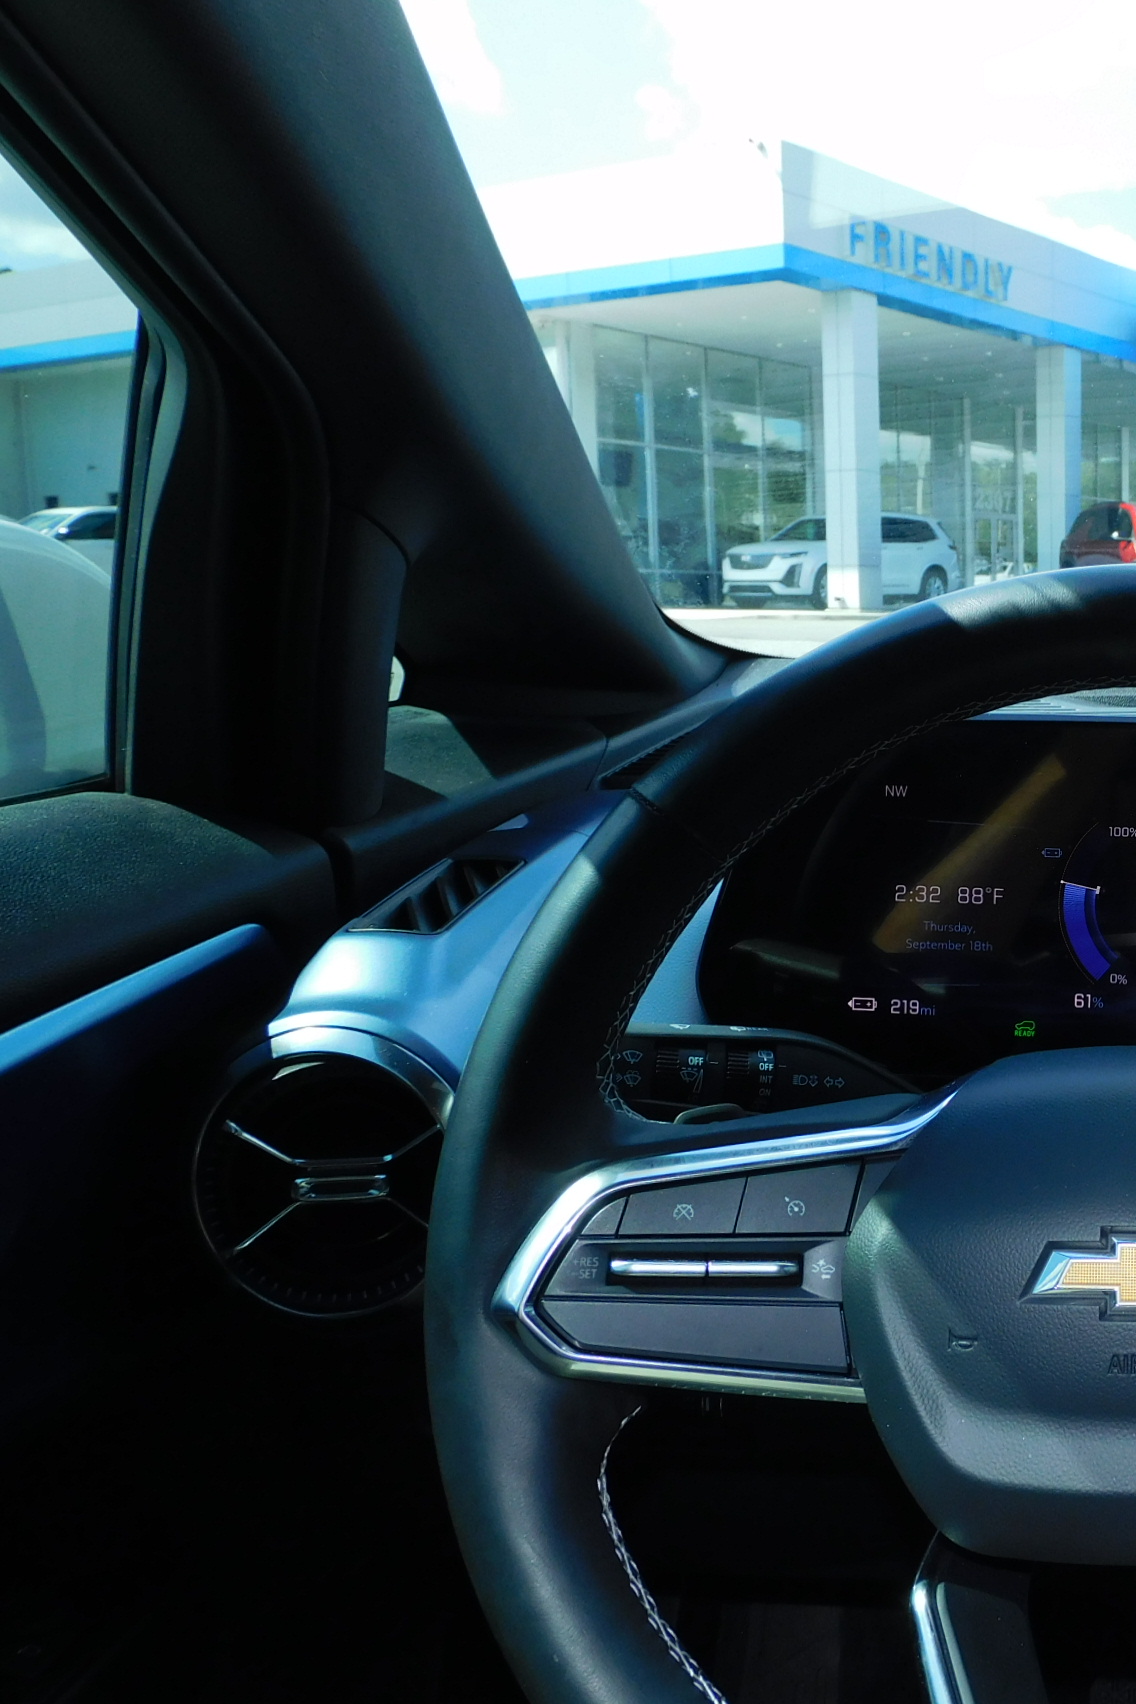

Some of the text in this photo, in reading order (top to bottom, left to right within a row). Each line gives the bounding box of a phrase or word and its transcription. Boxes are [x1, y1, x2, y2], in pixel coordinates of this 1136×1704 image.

[849, 217, 1014, 301] FRIENDLY
[885, 785, 908, 798] NW
[895, 885, 1004, 904] 2:32 88°F
[923, 921, 976, 935] Thursday,
[905, 939, 993, 954] September 18th
[1109, 973, 1128, 985] 0%
[1074, 993, 1104, 1009] 61%
[688, 1056, 704, 1066] OFF
[759, 1062, 774, 1071] OFF
[760, 1075, 773, 1084] INT
